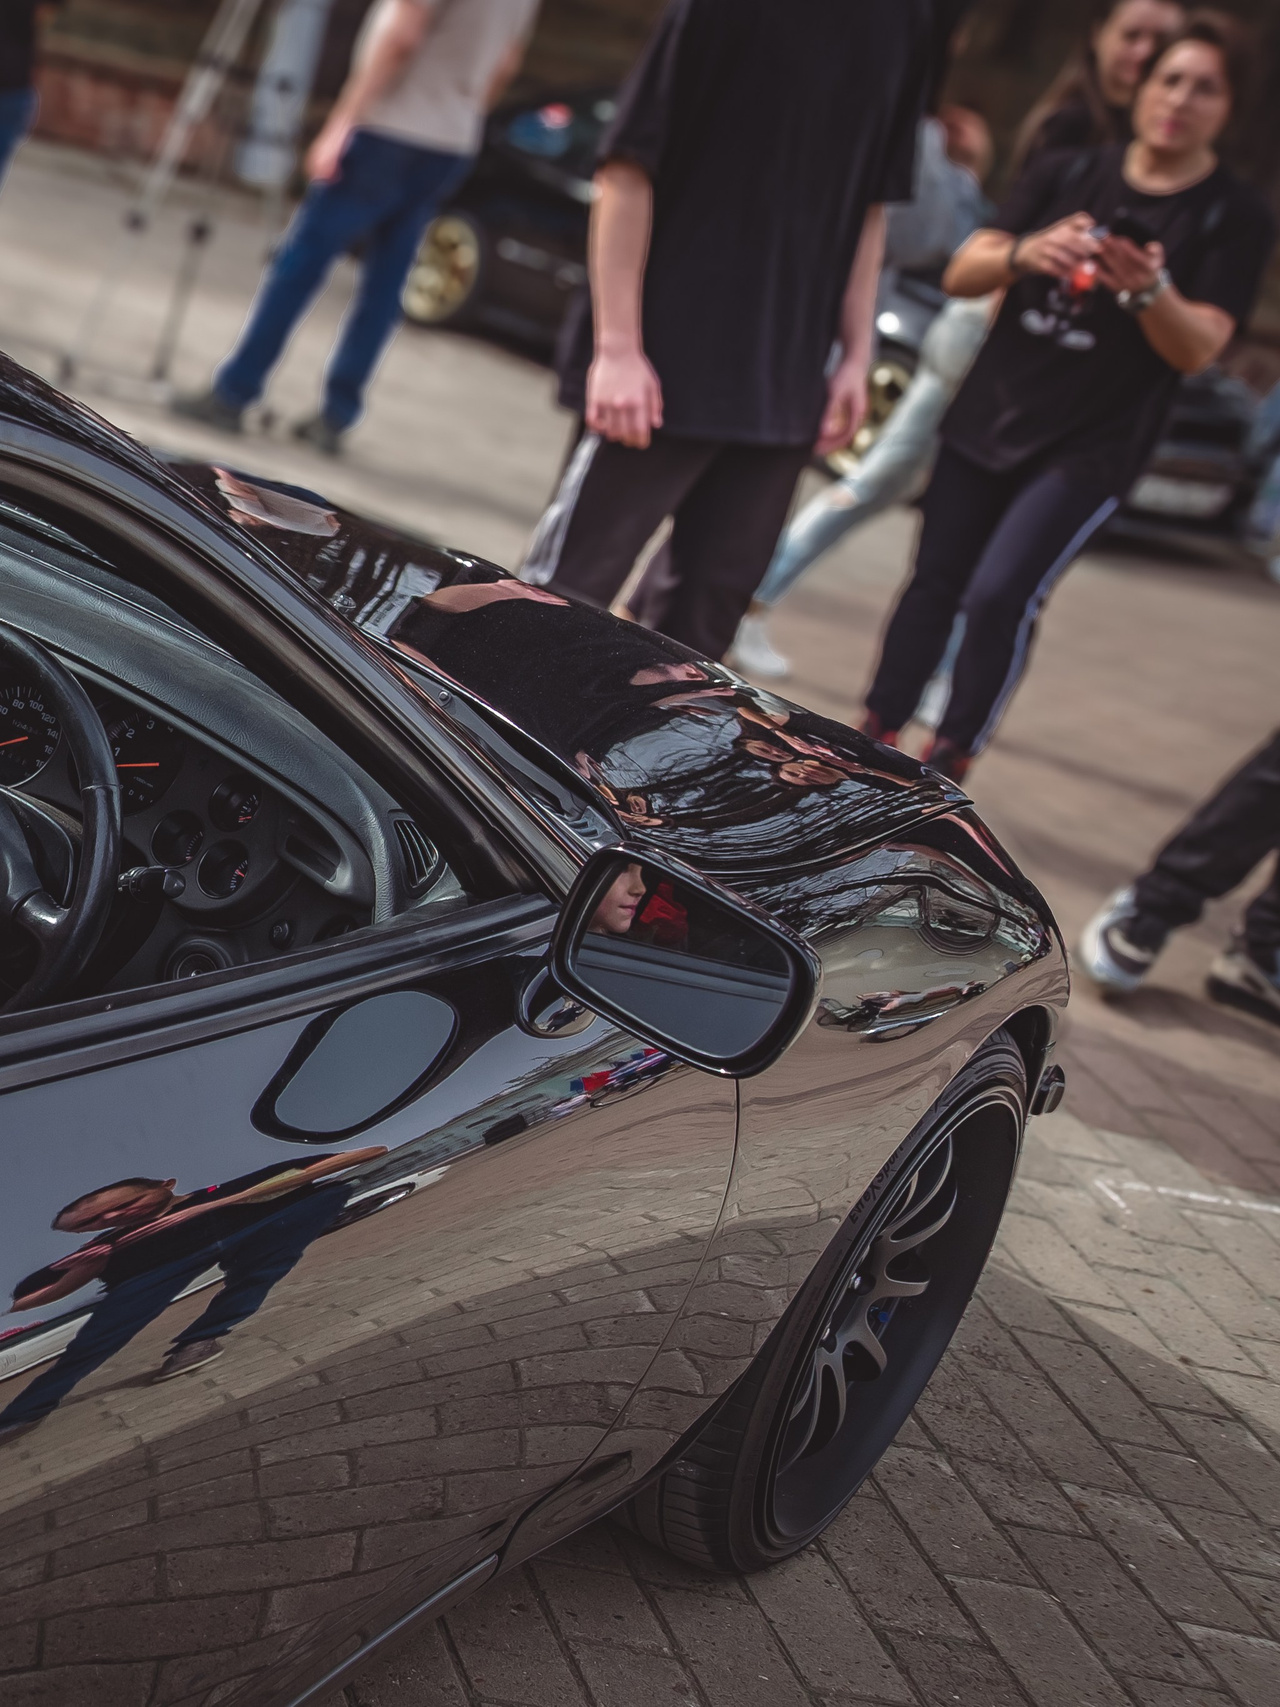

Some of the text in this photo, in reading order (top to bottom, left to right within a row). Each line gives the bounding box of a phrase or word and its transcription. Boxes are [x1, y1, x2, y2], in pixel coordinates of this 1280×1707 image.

[12, 699, 25, 710] 80
[29, 699, 44, 712] 100
[41, 712, 56, 724] 120
[146, 720, 155, 730] 3
[126, 728, 135, 739] 2
[44, 745, 54, 755] 16
[114, 747, 120, 756] 1
